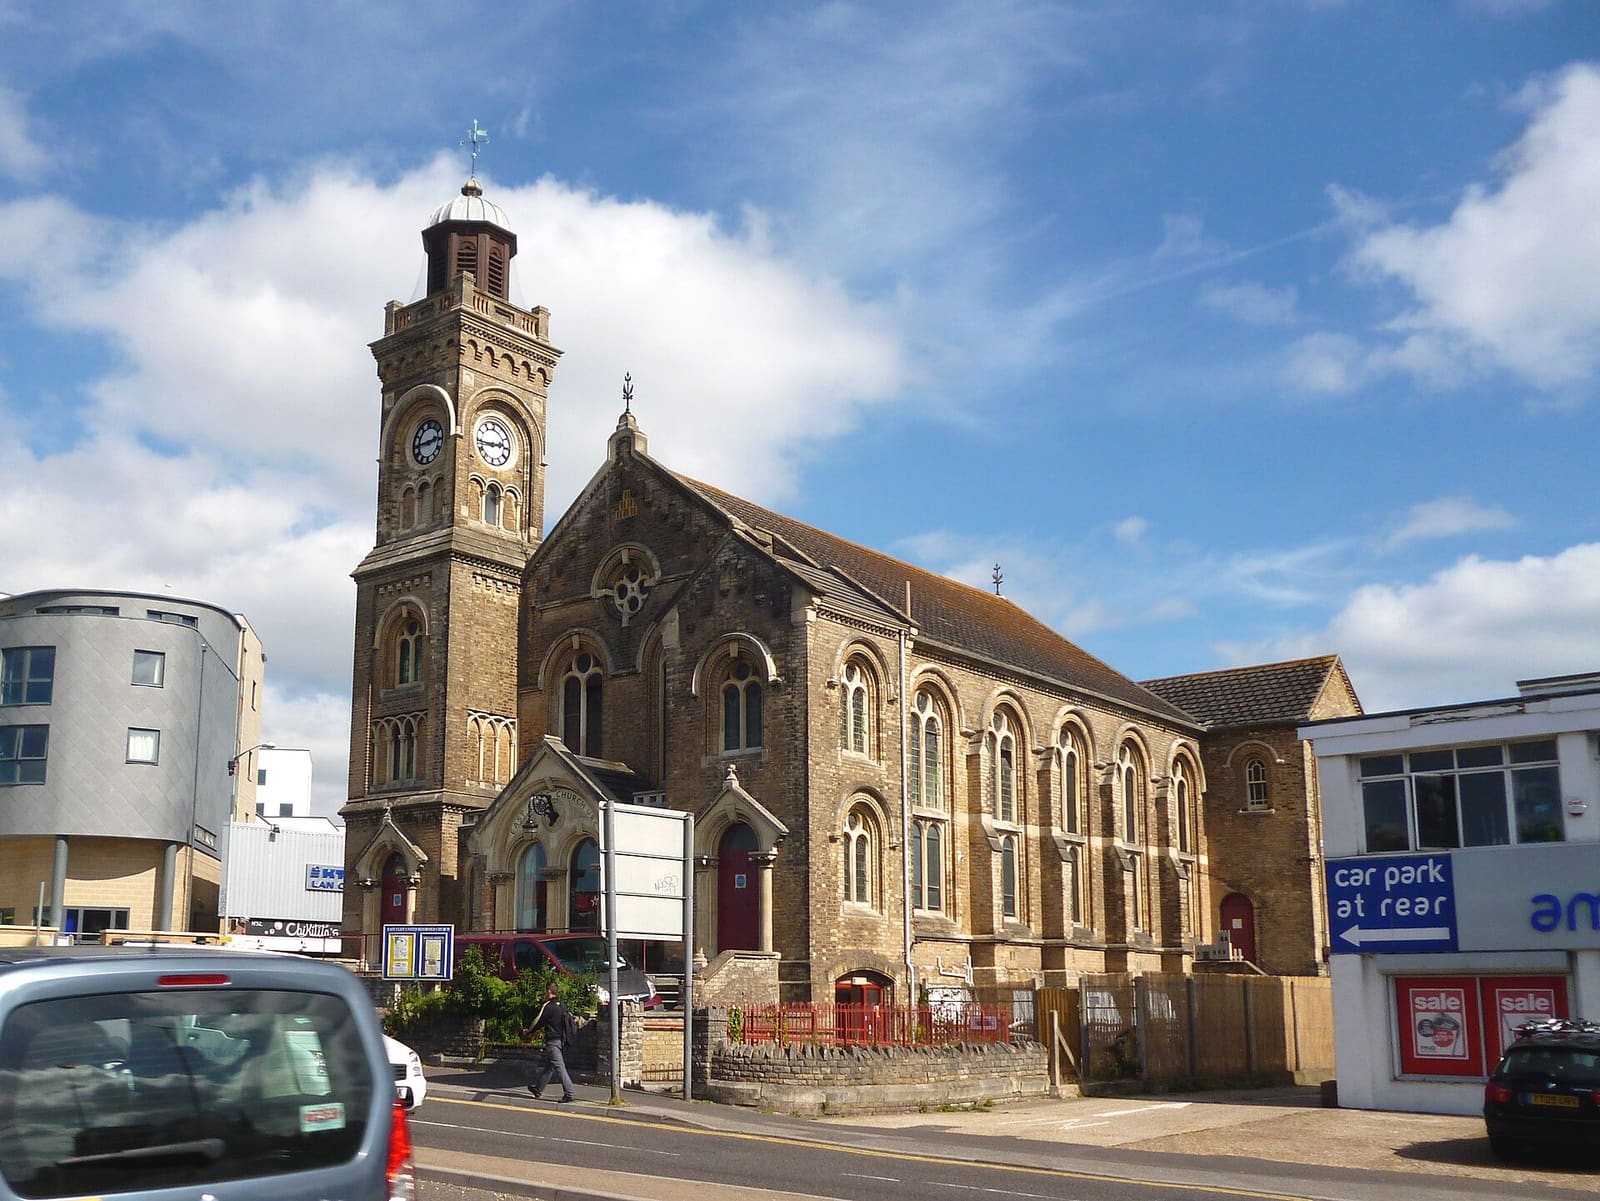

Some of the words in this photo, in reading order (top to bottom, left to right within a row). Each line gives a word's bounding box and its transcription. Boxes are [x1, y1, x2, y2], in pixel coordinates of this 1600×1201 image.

[555, 791, 585, 808] CHURCH
[311, 880, 334, 888] LAN
[1335, 868, 1376, 887] car
[1384, 859, 1445, 891] park
[1336, 893, 1365, 918] at
[1380, 896, 1447, 917] rear
[1414, 992, 1461, 1010] sale
[1501, 993, 1550, 1011] sale
